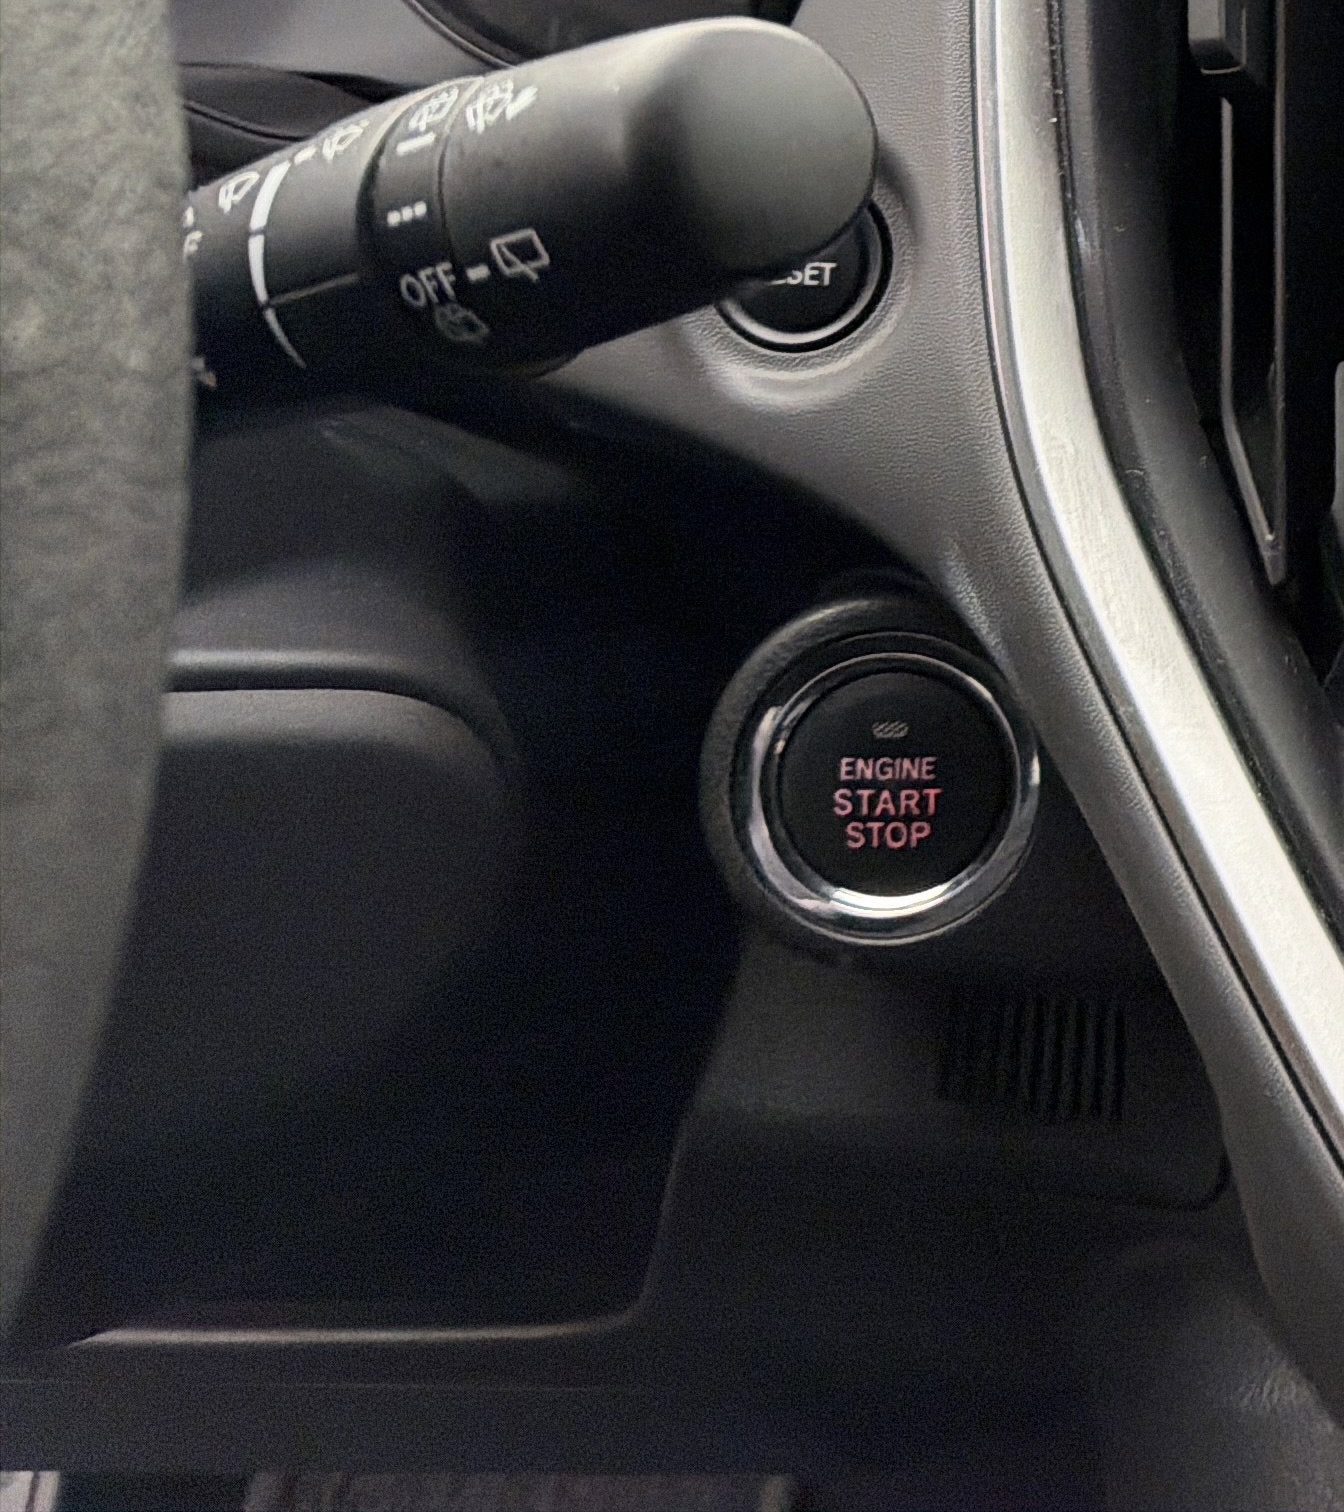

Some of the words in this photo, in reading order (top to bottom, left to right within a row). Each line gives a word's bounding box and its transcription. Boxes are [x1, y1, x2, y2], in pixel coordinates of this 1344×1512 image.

[400, 261, 456, 308] OFF
[839, 756, 938, 781] ENGINE
[832, 788, 942, 818] START
[845, 821, 932, 849] STOP
